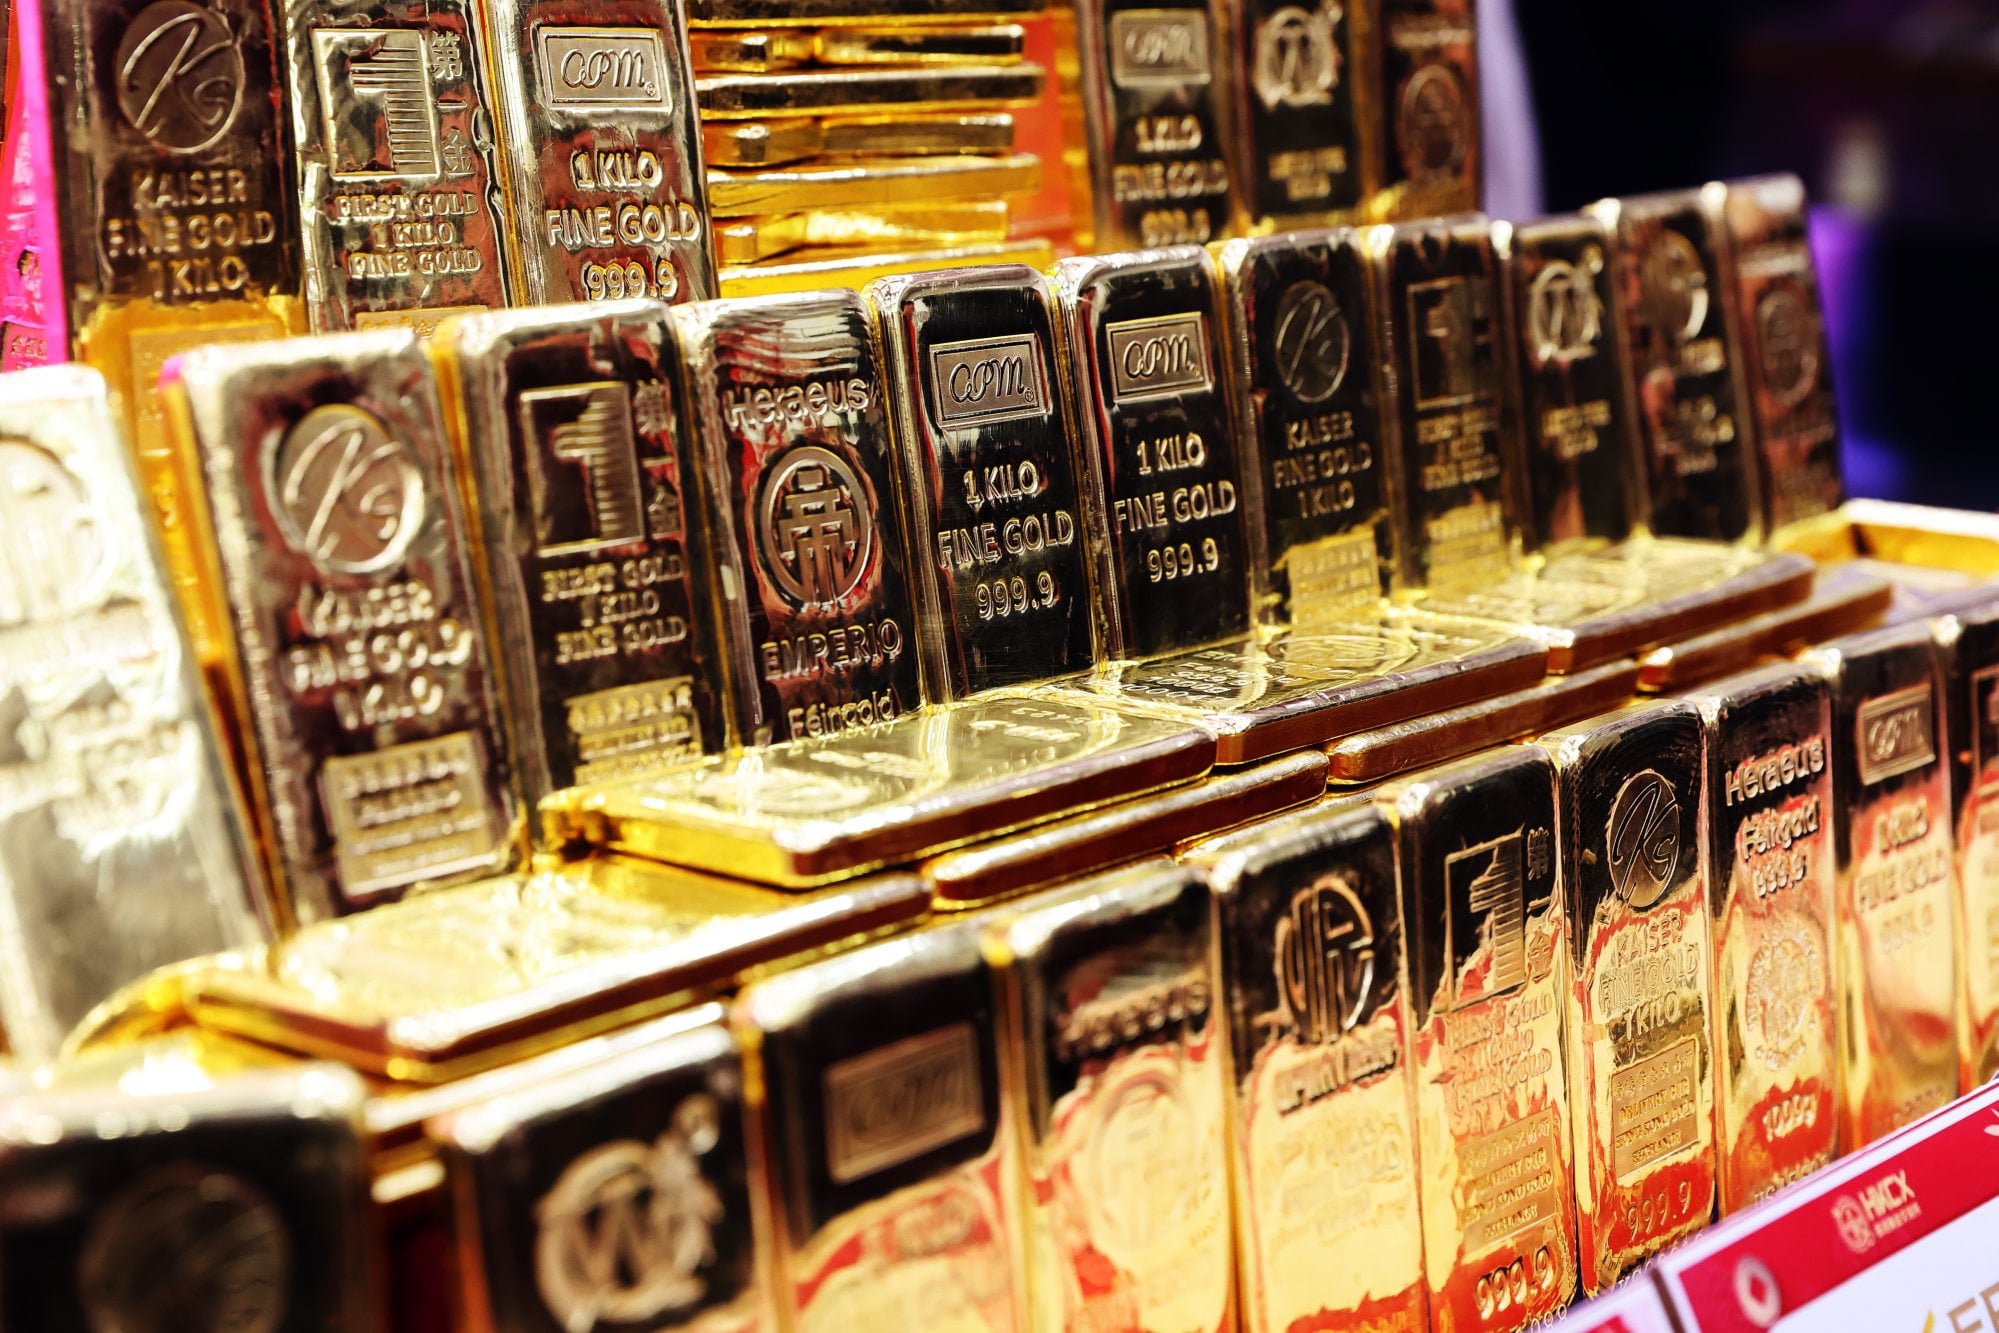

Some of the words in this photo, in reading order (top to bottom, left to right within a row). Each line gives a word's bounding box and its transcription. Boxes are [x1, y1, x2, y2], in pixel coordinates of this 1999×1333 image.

[133, 169, 247, 210] KAISER
[571, 151, 594, 191] 1
[598, 150, 664, 191] KILO
[335, 194, 411, 219] FIRST
[416, 191, 480, 216] GOLD
[544, 206, 614, 250] FINE
[619, 201, 700, 245] GOLD
[187, 210, 275, 250] GOLD
[374, 225, 387, 248] 1
[392, 222, 454, 247] KILO
[169, 255, 248, 296] KILO
[349, 252, 409, 280] FINE
[417, 249, 483, 276] GOLD
[583, 259, 678, 301] 999.9
[724, 378, 870, 429] Heraeus
[1137, 440, 1151, 475] 1
[1156, 432, 1206, 472] KILO
[1286, 411, 1354, 451] KAISER
[963, 470, 980, 505] 1
[983, 460, 1040, 502] KILO
[1273, 458, 1316, 489] FINE
[1320, 441, 1373, 478] GOLD
[1113, 492, 1166, 535] FINE
[1174, 480, 1237, 523] GOLD
[1312, 479, 1355, 514] KILO
[937, 522, 998, 570] FINE
[1002, 510, 1074, 555] GOLD
[1147, 538, 1219, 583] 999.9
[622, 554, 684, 587] GOLD
[601, 590, 659, 624] KILO
[976, 570, 1056, 620] 999.9
[624, 616, 687, 650] GOLD
[761, 618, 901, 681] EMPERIO
[788, 690, 895, 742] Feingold
[1725, 736, 1825, 807] Heraeus
[1742, 796, 1819, 861] Feingold
[1617, 911, 1683, 966] KAISER
[1600, 966, 1642, 1016] FINE
[1645, 943, 1698, 990] GOLD
[1635, 990, 1681, 1037] KILO
[1627, 1179, 1692, 1241] 999.9
[1475, 1245, 1553, 1320] 999.9
